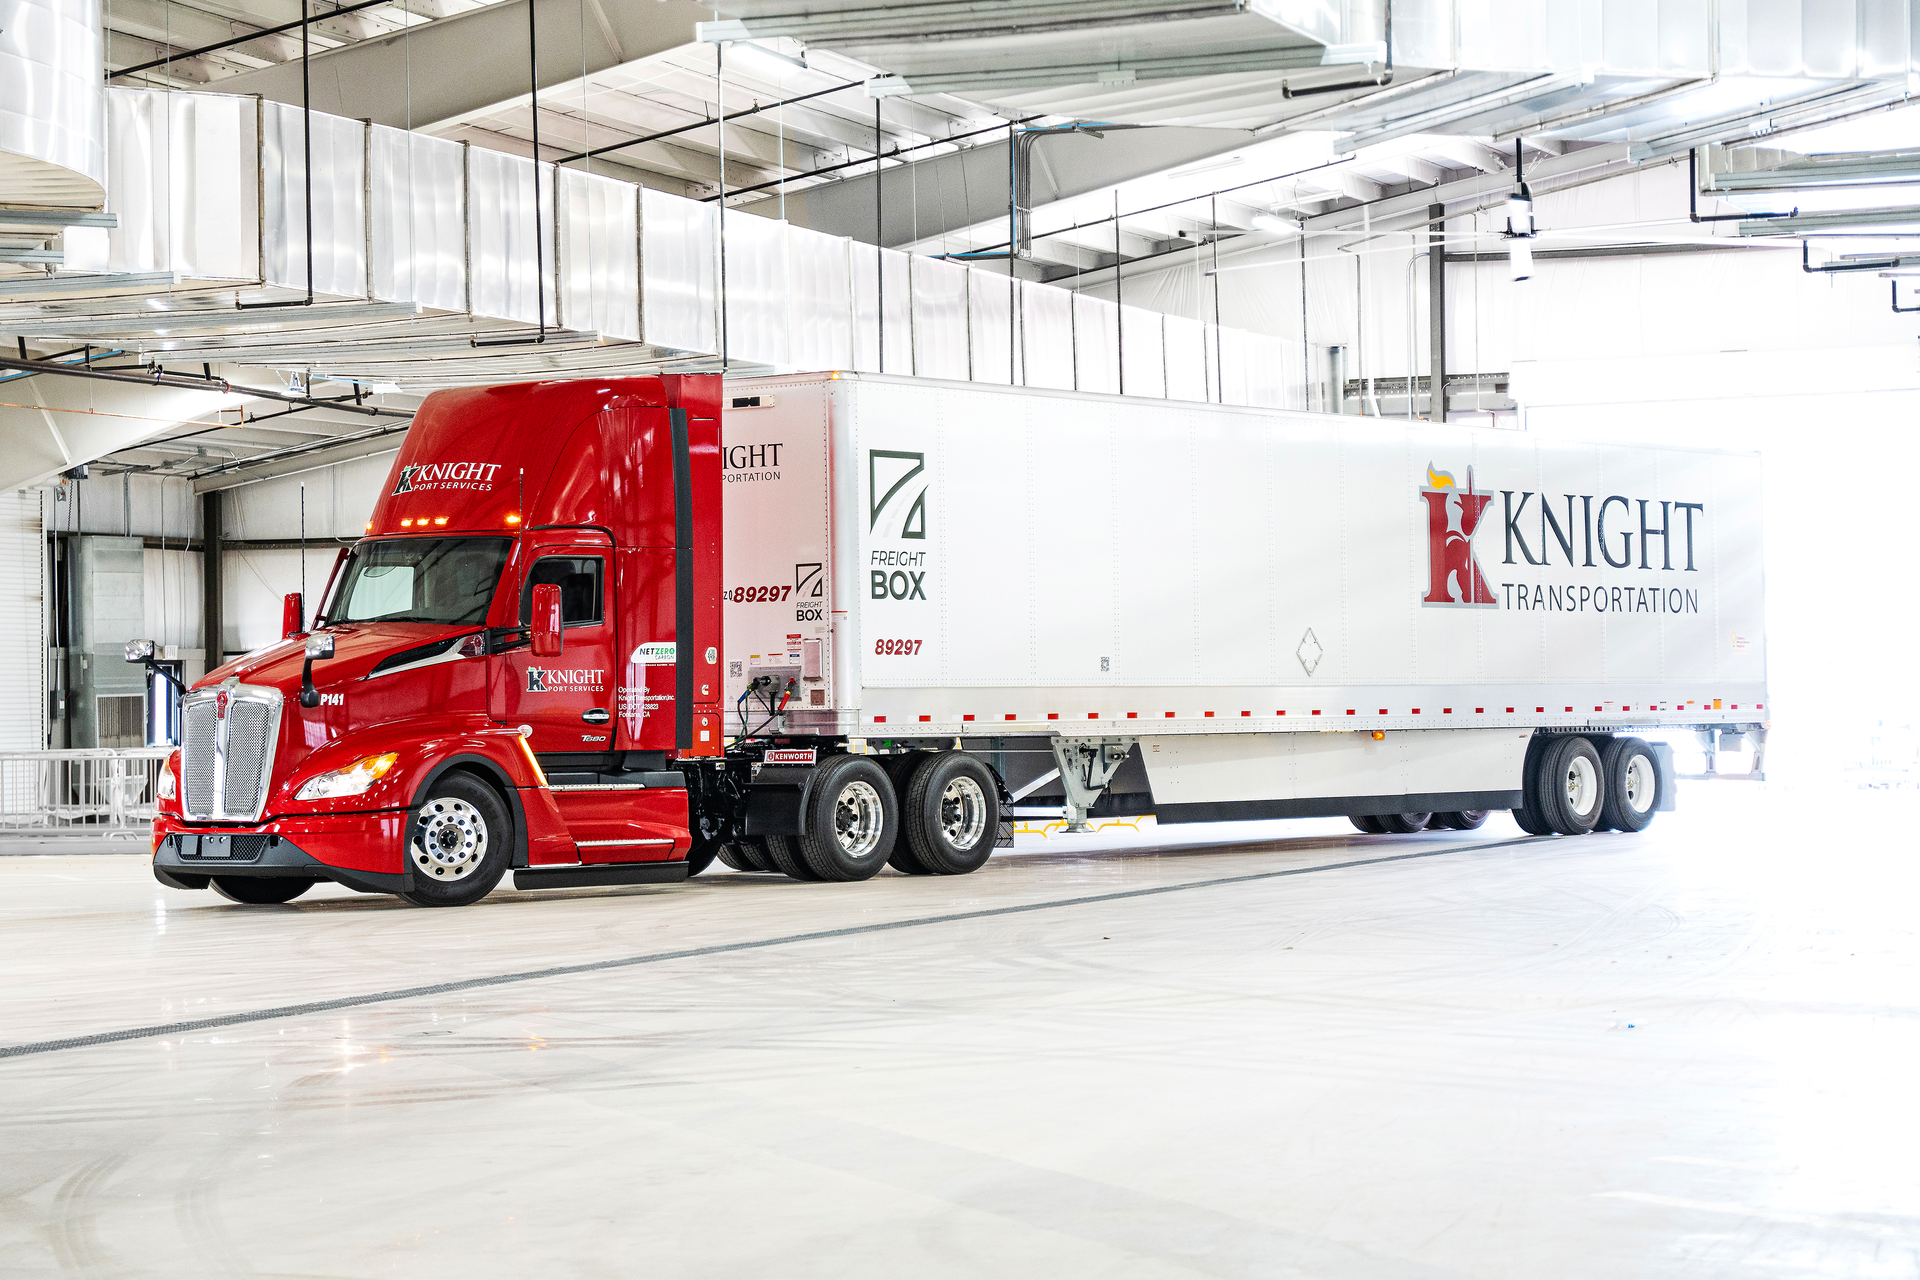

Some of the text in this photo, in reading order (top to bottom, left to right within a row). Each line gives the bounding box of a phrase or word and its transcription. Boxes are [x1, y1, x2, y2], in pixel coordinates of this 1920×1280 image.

[723, 443, 783, 469] IGHT
[416, 462, 502, 482] KNIGHT
[722, 471, 781, 483] PORTATION
[413, 481, 493, 491] PORT SERVICES
[1499, 489, 1704, 572] KNIGHT
[870, 550, 927, 567] FREIGHT
[870, 569, 927, 601] BOX
[733, 585, 792, 603] 89297
[1501, 583, 1699, 614] TRANSPORTATION
[796, 601, 823, 609] FREIGHT
[796, 608, 823, 621] BOX
[874, 638, 923, 656] 89297
[547, 669, 604, 684] KNIGHT
[320, 693, 344, 706] P141
[774, 752, 813, 760] KENWORTH
